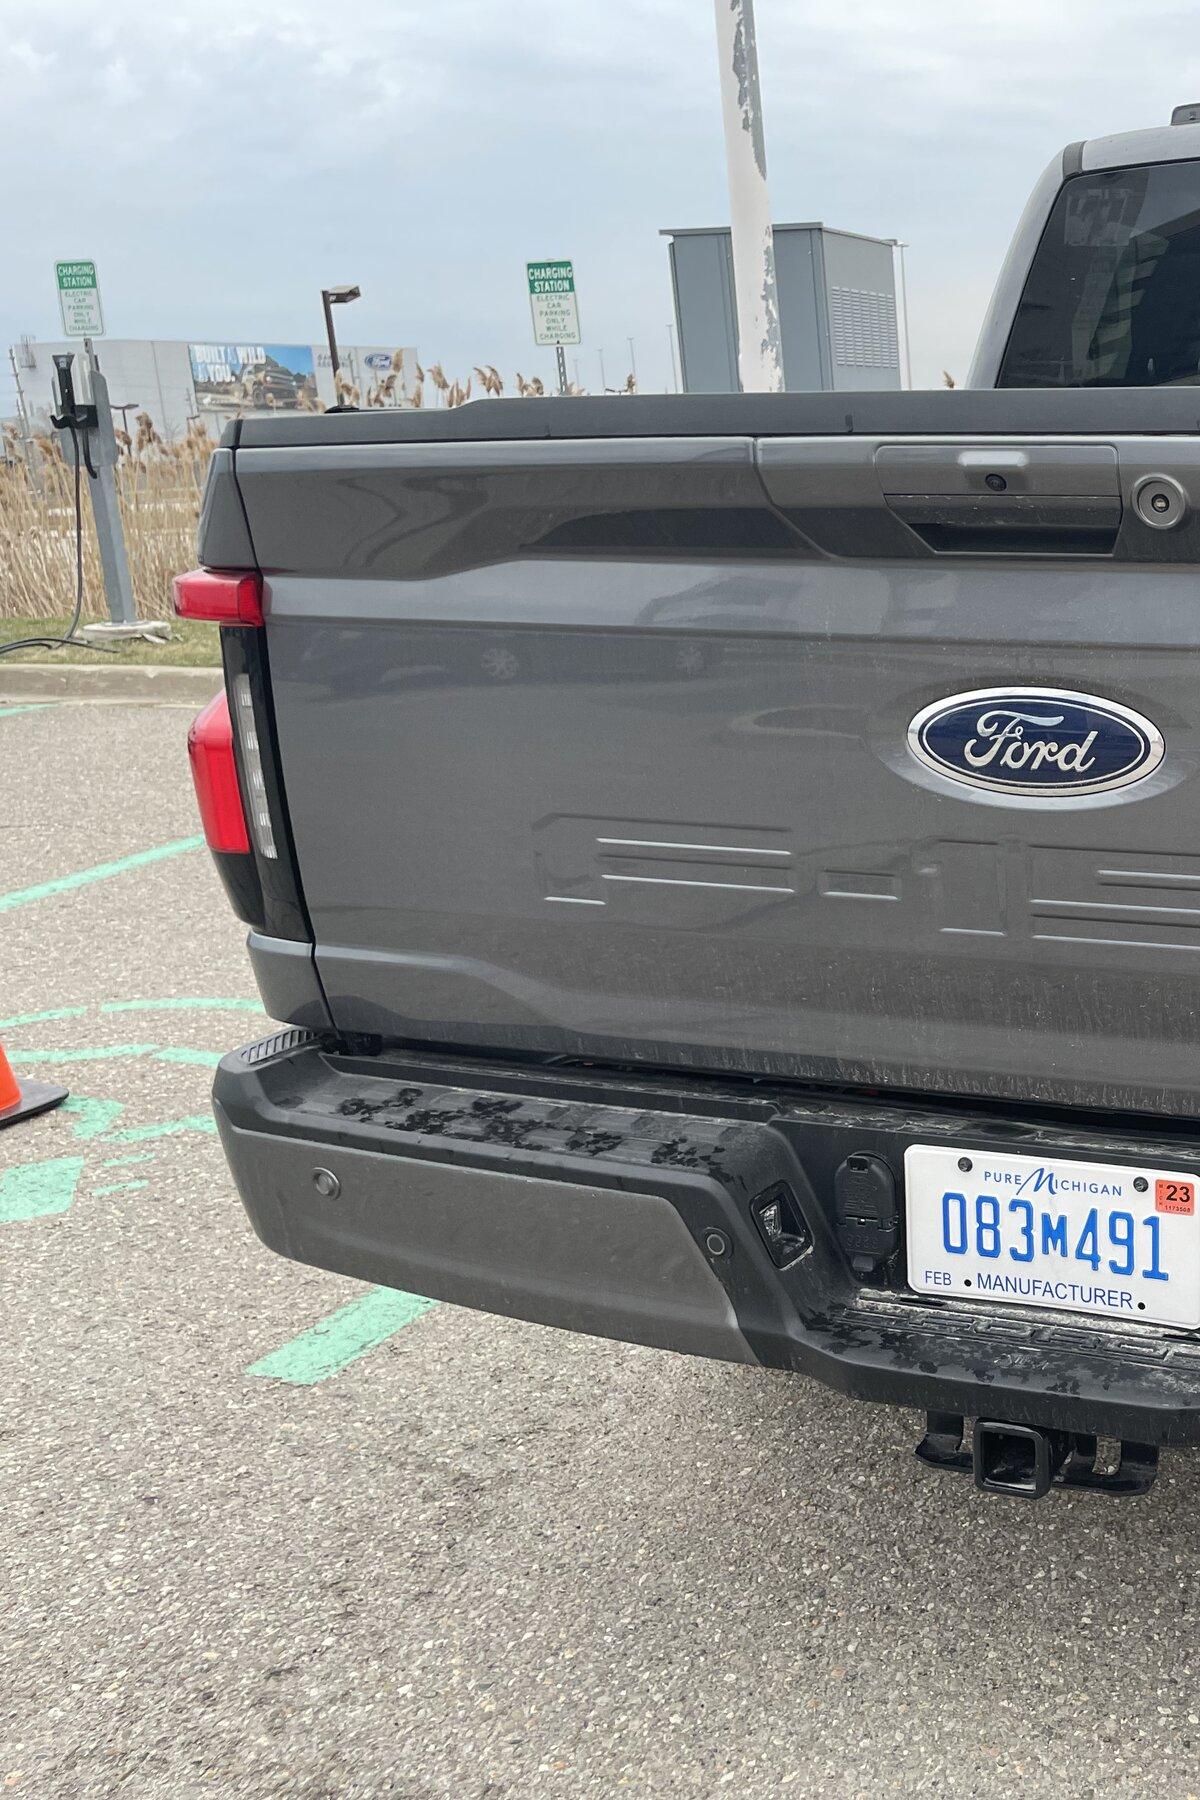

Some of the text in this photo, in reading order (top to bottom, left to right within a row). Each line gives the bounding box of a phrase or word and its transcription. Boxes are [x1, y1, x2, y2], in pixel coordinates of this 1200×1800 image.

[58, 265, 94, 277] CHARGING
[528, 266, 573, 280] CHARGING
[62, 276, 93, 287] STATION
[534, 279, 570, 293] STATION
[537, 294, 570, 302] ELECTRIC
[540, 309, 571, 317] PARKING
[539, 332, 576, 340] CHARGING
[964, 710, 1099, 773] Ford
[983, 1167, 1123, 1197] PURE MICHIGAN
[1166, 1184, 1191, 1203] 23
[941, 1191, 1169, 1281] 083M491
[924, 1270, 1134, 1310] FEB MANUFACTURER
